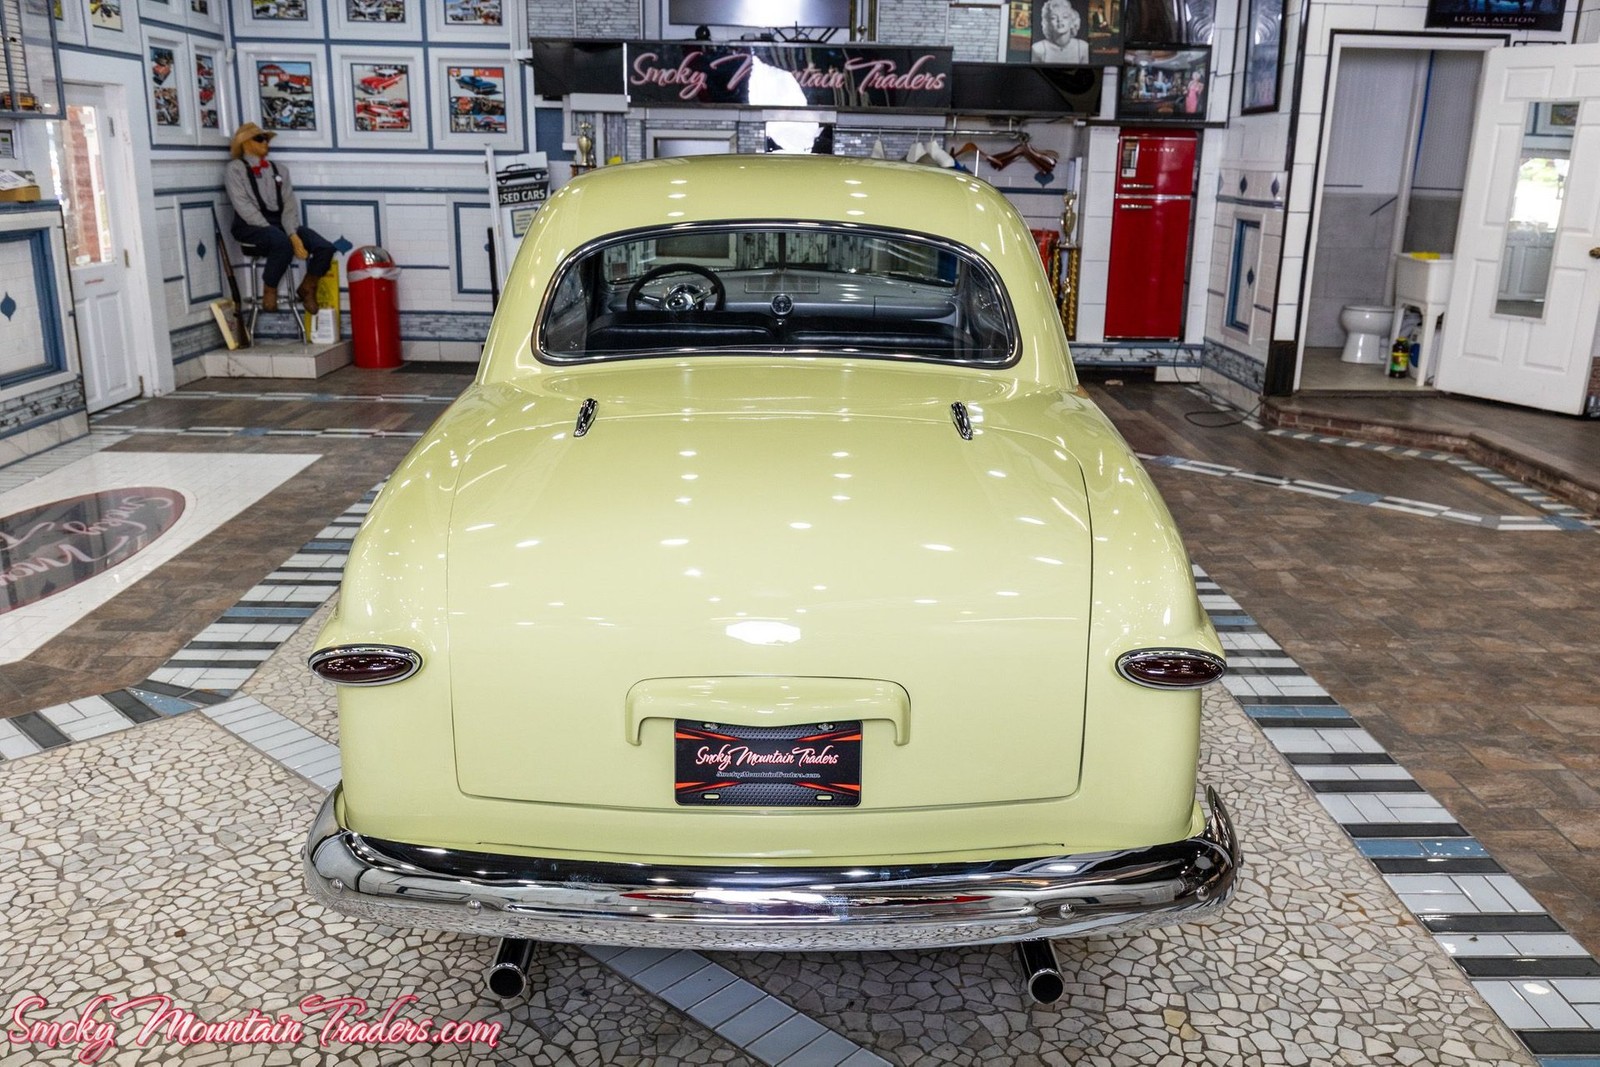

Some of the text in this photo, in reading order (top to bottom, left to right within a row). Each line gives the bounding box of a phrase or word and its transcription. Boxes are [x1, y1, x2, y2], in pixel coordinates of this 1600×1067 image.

[1454, 16, 1488, 24] LEGAL
[1492, 16, 1537, 25] ACTION
[630, 51, 708, 99] Smoky
[844, 54, 947, 95] Traders
[521, 189, 546, 201] CARS
[695, 743, 839, 770] Smoky Mountain Traders
